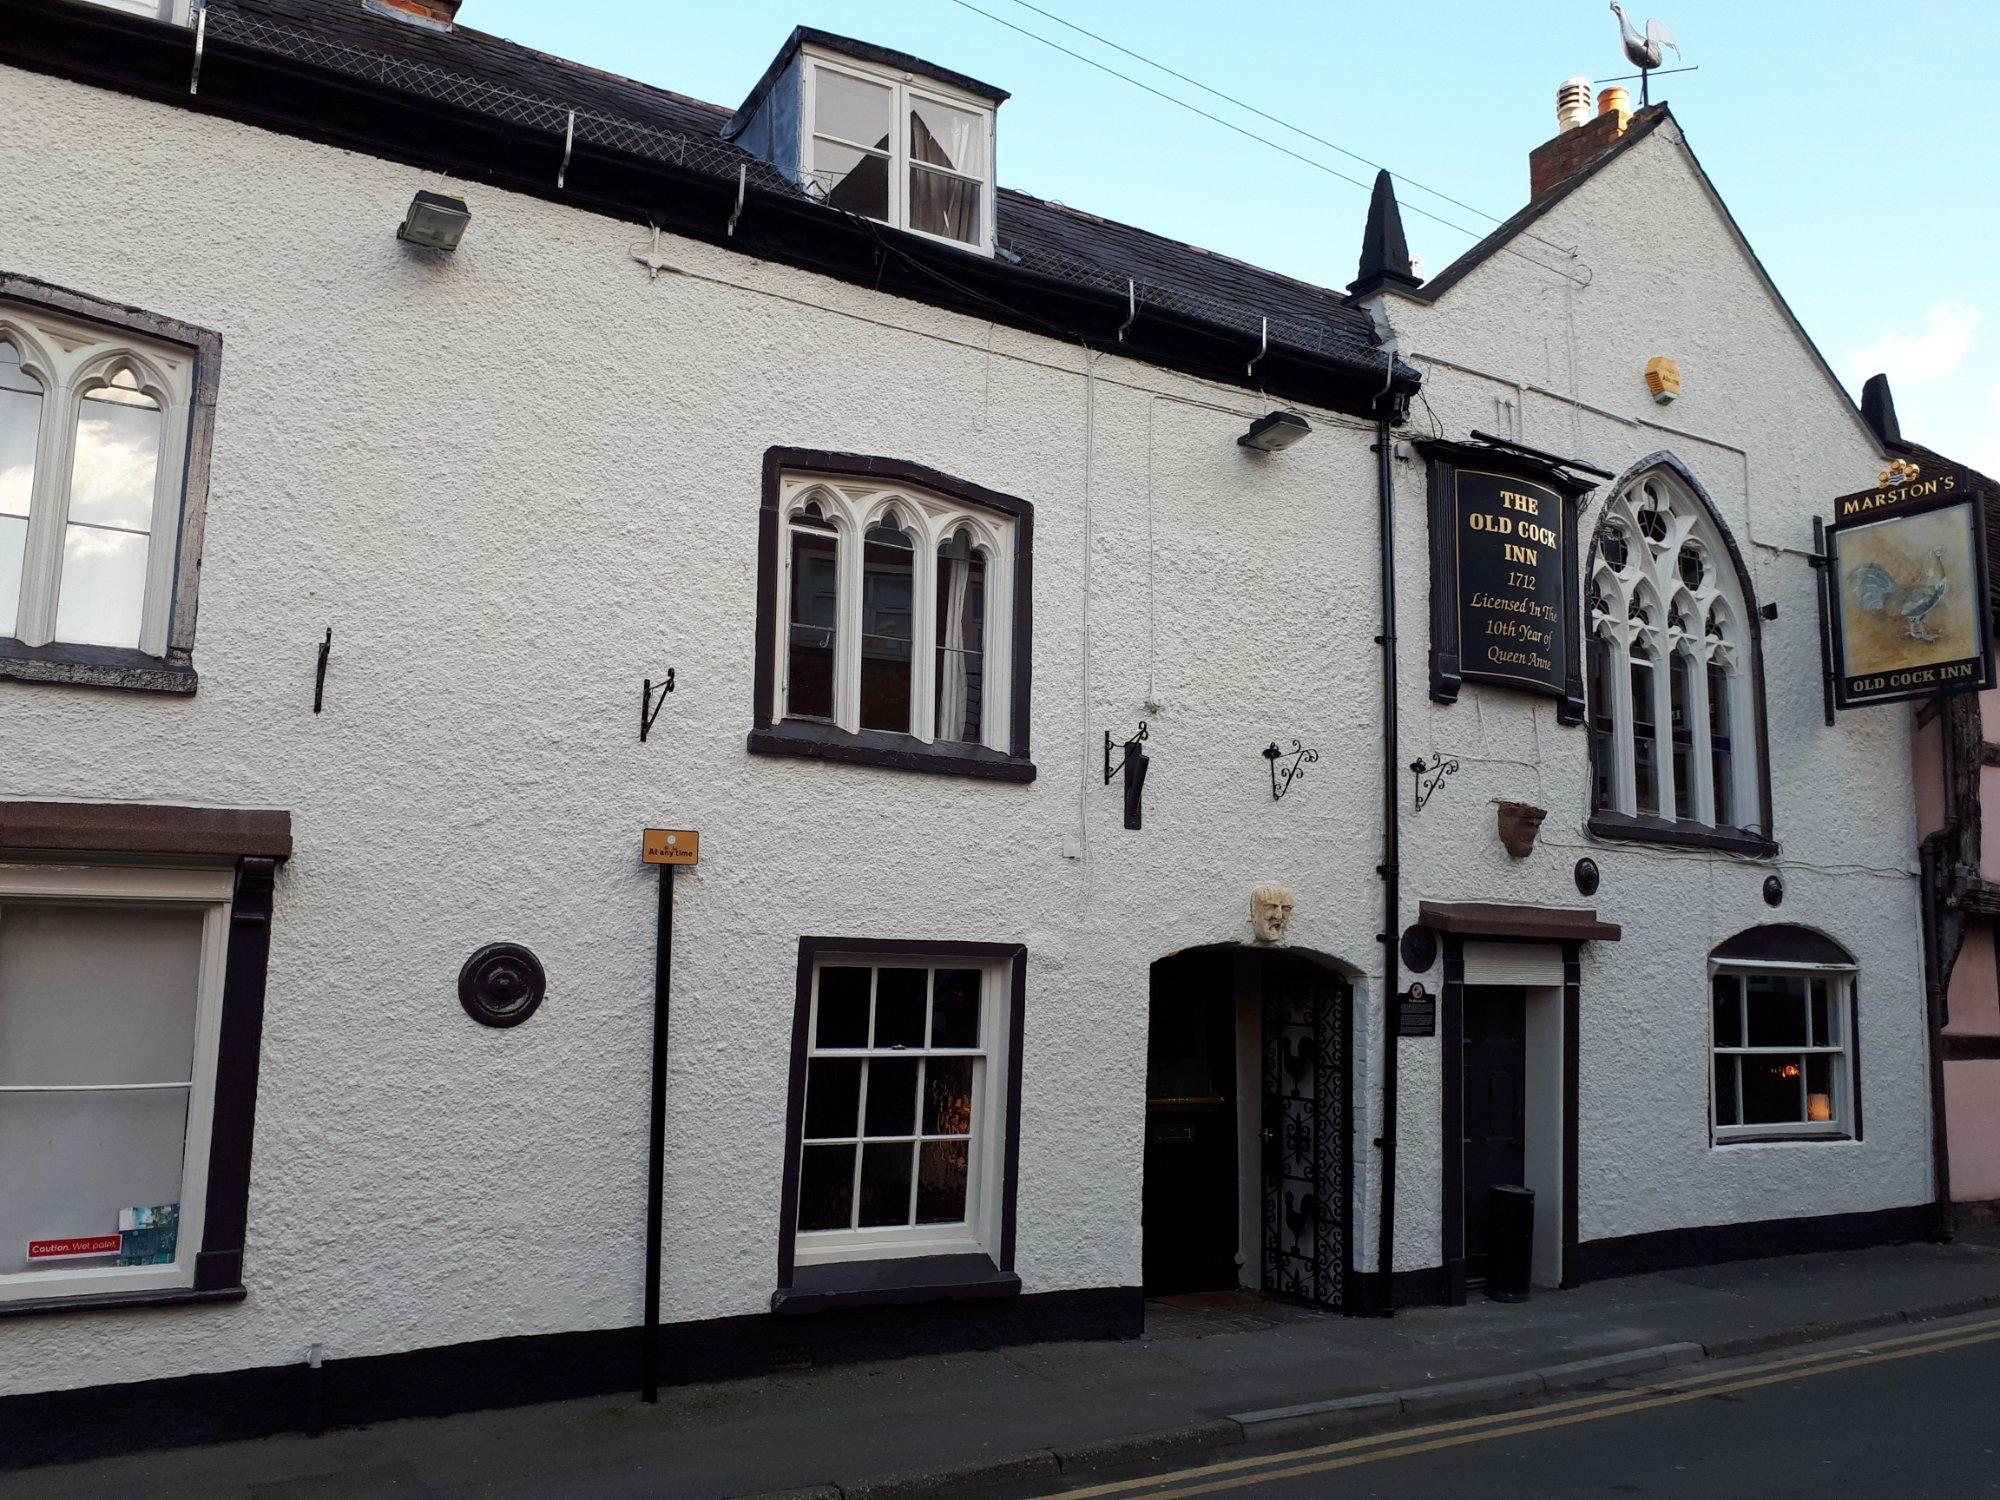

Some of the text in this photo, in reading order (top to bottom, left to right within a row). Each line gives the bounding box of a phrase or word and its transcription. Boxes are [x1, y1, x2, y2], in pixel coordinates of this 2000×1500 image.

[1500, 490, 1538, 516] THE
[1843, 475, 1955, 515] MARSTON'S
[1469, 512, 1557, 550] OLD COCK
[1504, 543, 1538, 567] INN
[1507, 571, 1536, 591] 1712
[1470, 593, 1558, 623] Licensed In The
[1485, 619, 1553, 652] 10th Year of
[1488, 645, 1552, 671] Queen Anne
[1853, 663, 1973, 693] OLD COCK INN
[648, 848, 693, 857] At any time
[72, 1242, 91, 1251] Wet
